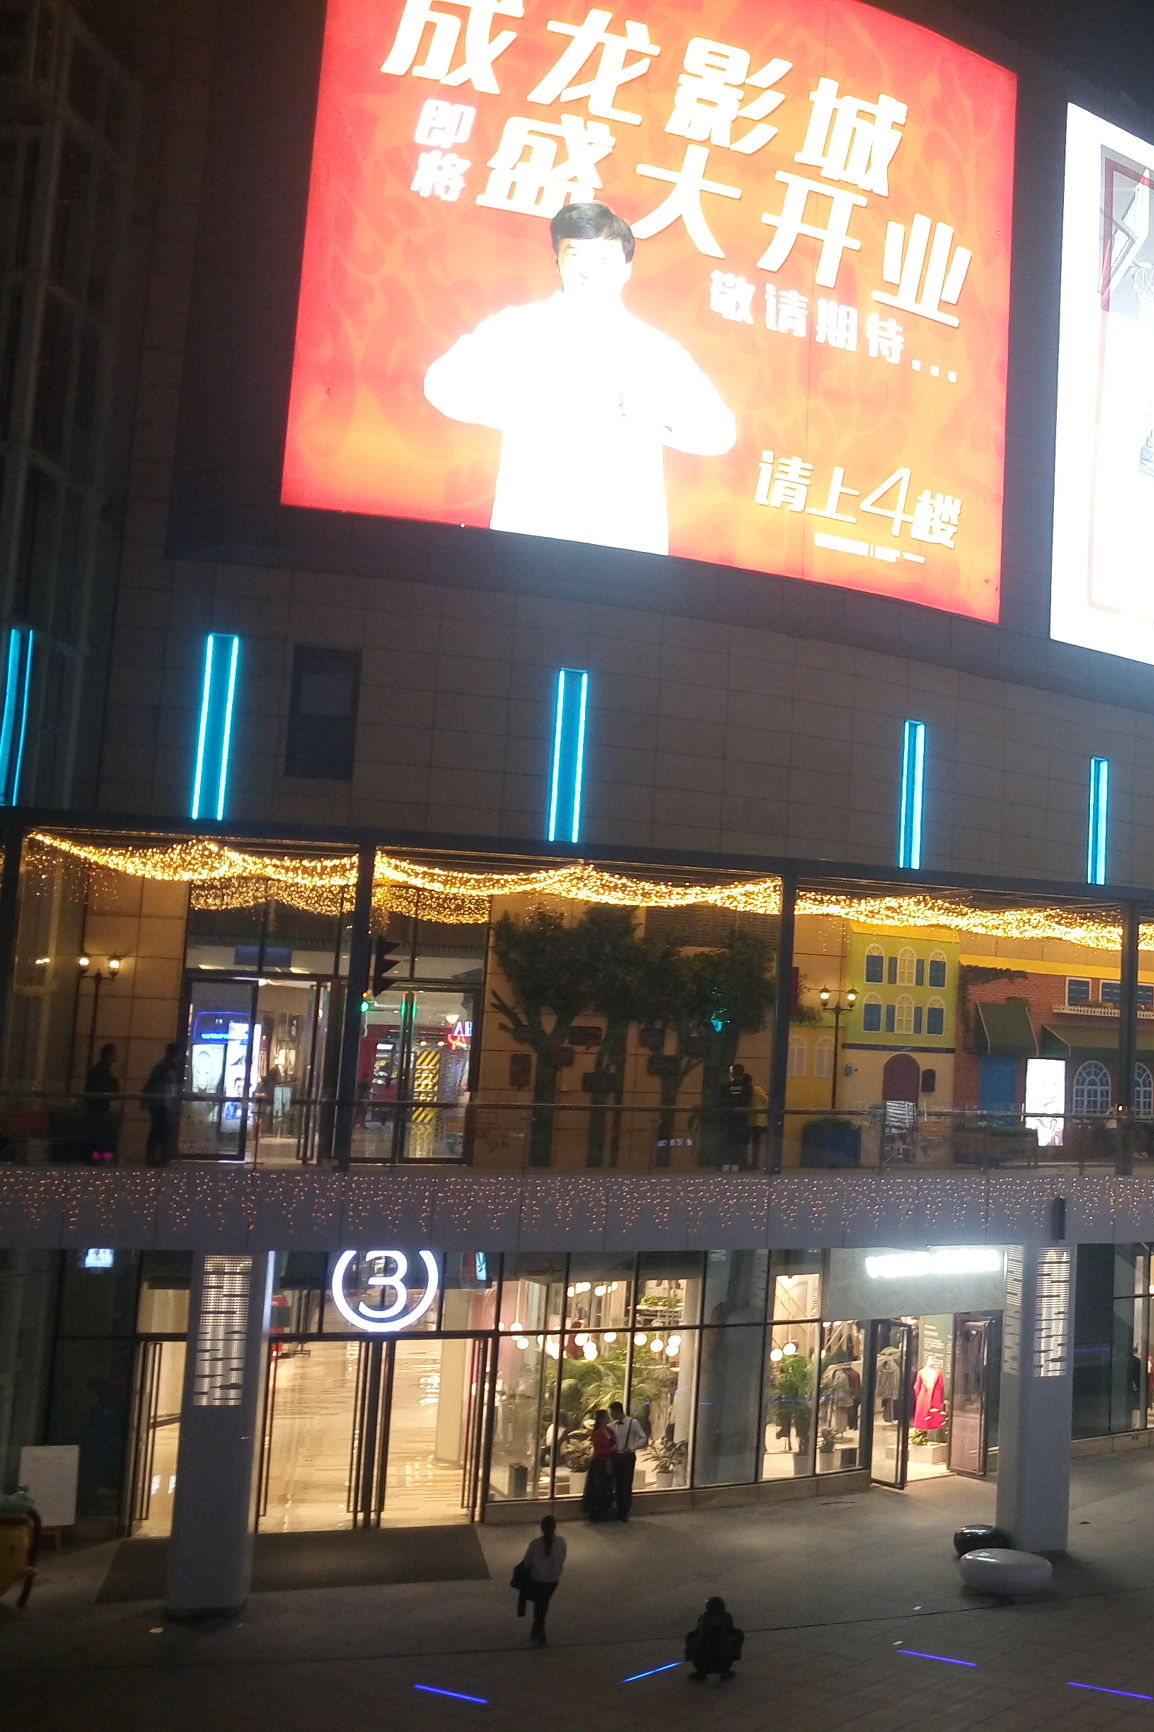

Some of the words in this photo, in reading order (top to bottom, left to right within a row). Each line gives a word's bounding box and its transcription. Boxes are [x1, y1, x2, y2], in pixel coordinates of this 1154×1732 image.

[380, 0, 908, 197] 成龙影城
[410, 98, 475, 203] 即将
[475, 113, 973, 328] 盛大开业
[754, 450, 964, 549] 请上4楼
